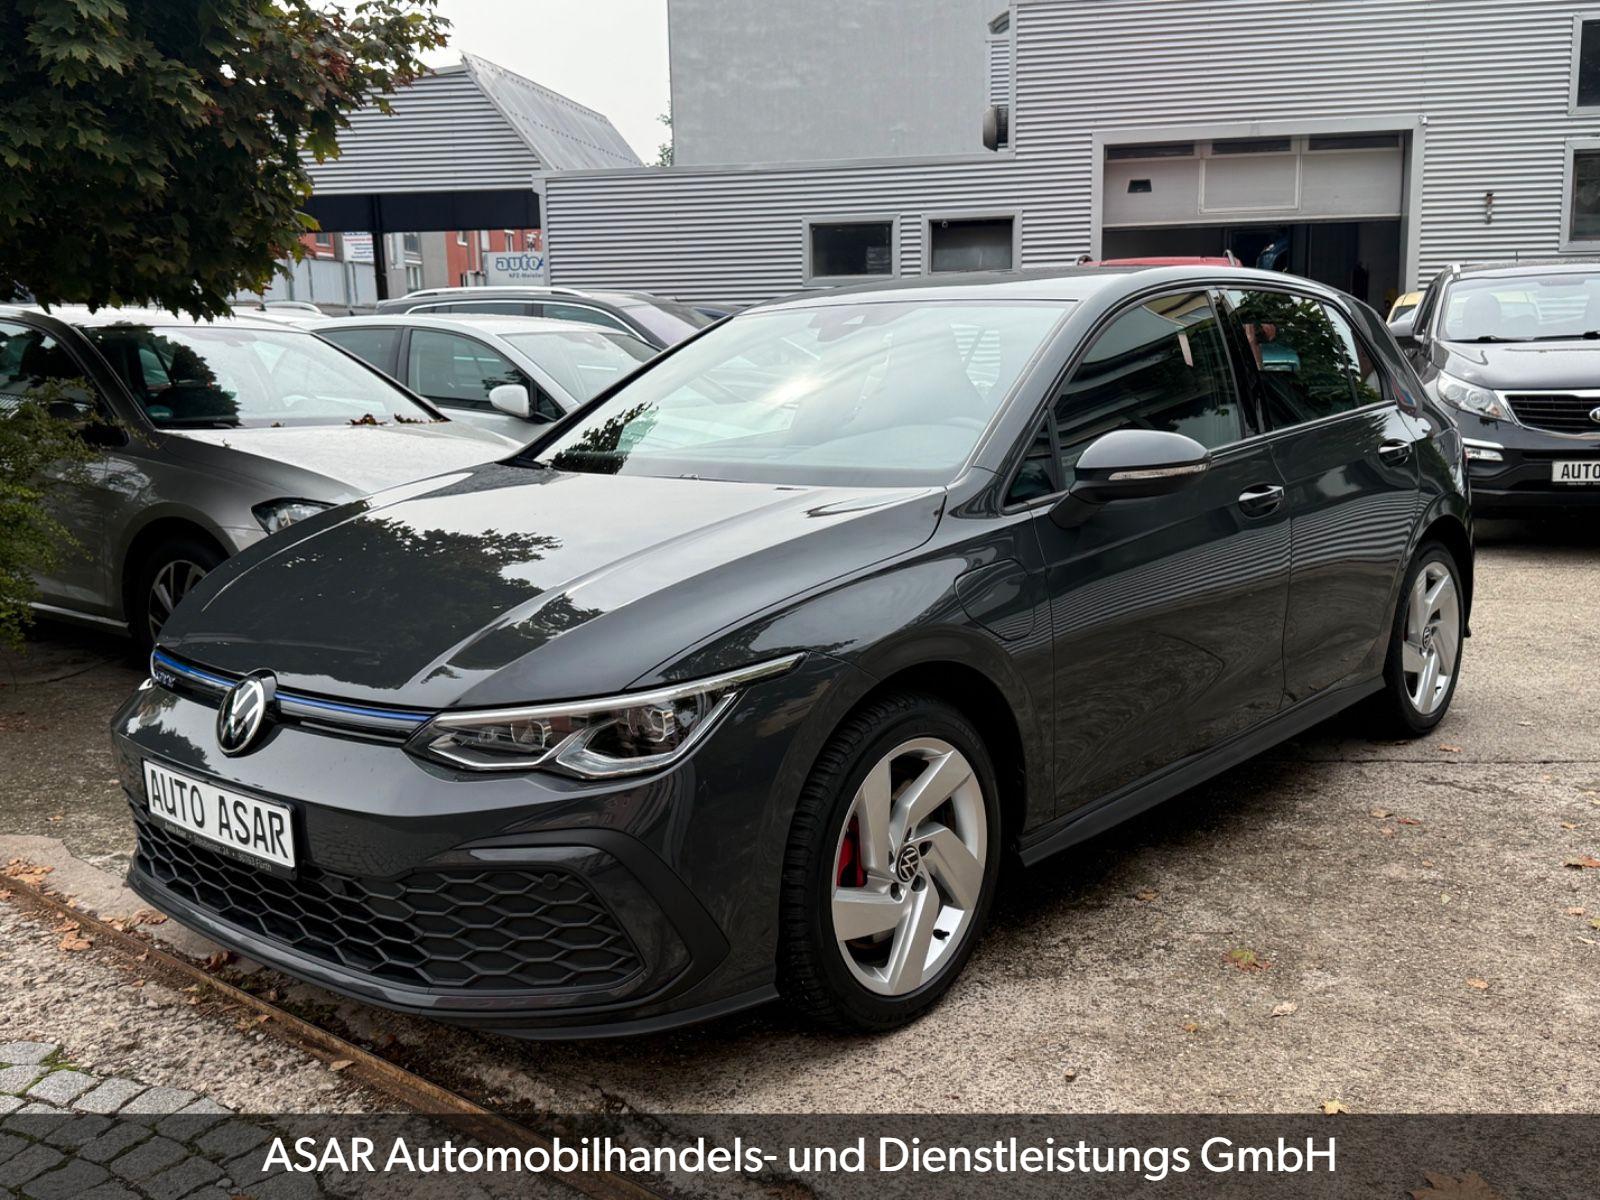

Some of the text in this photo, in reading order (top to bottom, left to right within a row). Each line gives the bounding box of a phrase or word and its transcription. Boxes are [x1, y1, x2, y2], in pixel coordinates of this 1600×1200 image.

[1561, 463, 1600, 479] AUTO
[151, 769, 289, 860] AUTO ASAR
